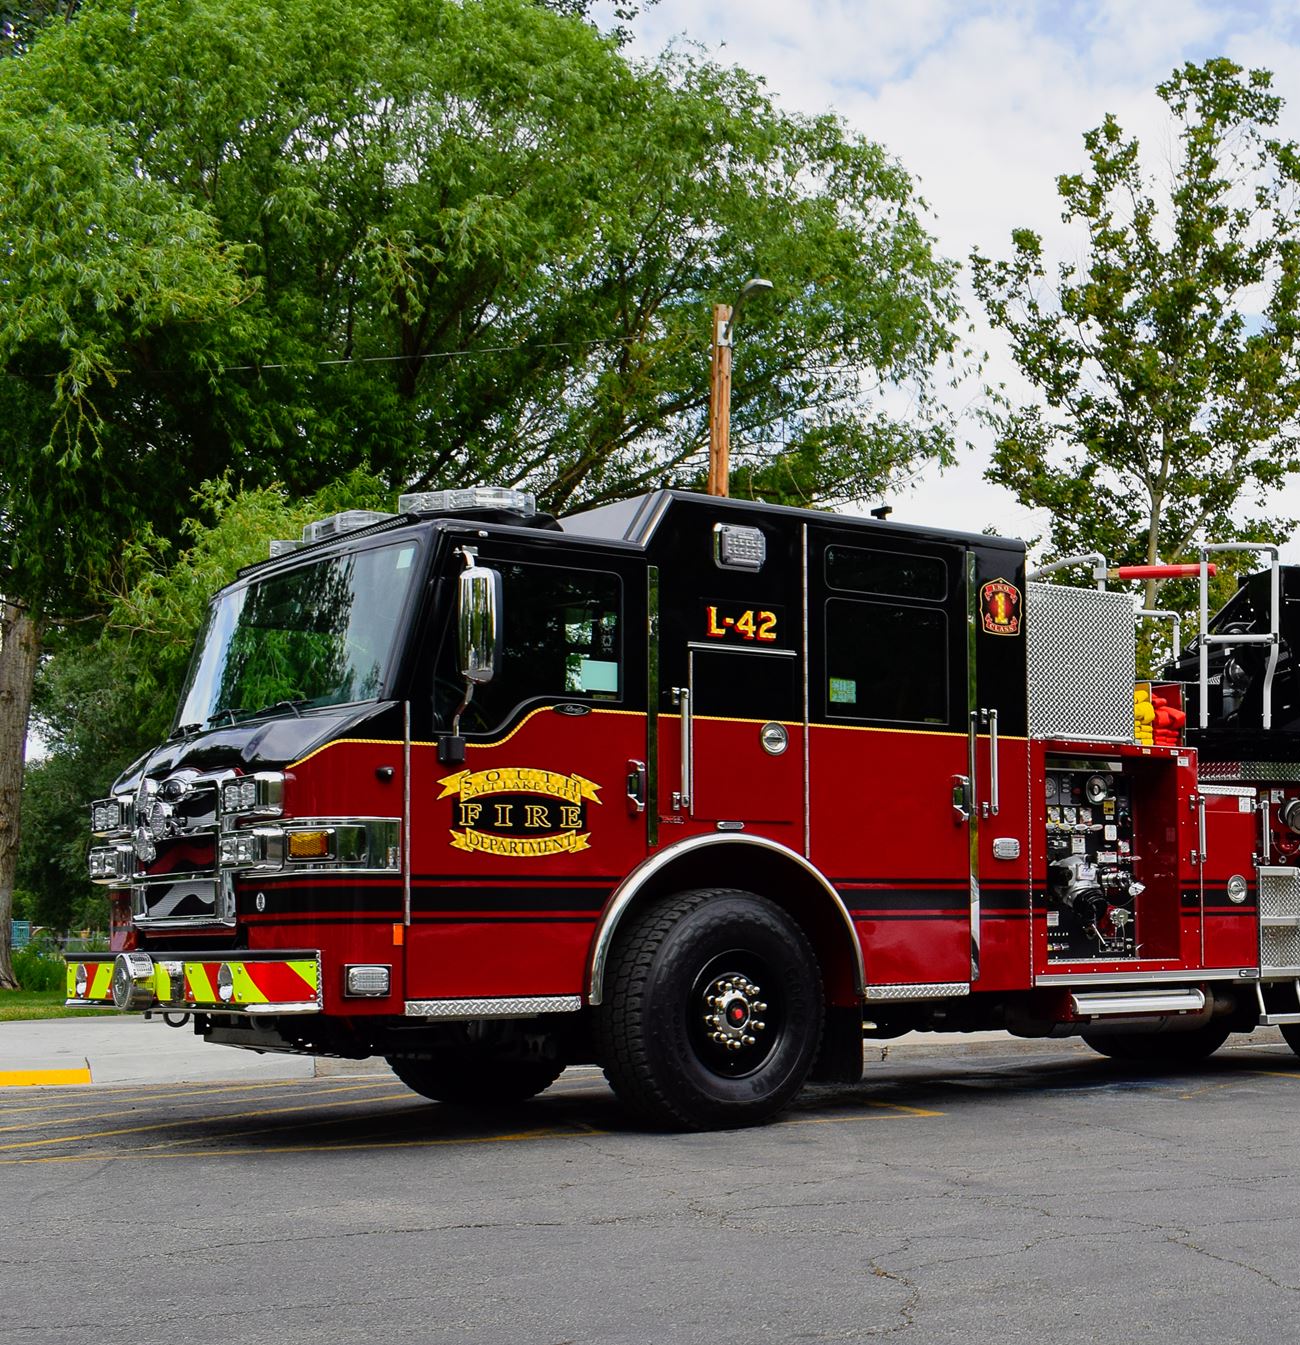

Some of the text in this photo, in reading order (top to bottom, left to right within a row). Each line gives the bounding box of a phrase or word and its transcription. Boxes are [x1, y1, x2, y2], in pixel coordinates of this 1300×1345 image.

[994, 592, 1009, 625] 1
[706, 606, 778, 641] L-42
[989, 623, 1015, 632] CLASS
[463, 778, 579, 801] SALT LAKE CITY
[464, 770, 577, 791] SOUTH
[458, 803, 583, 829] FIRE
[468, 832, 575, 855] DEPARTMENT
